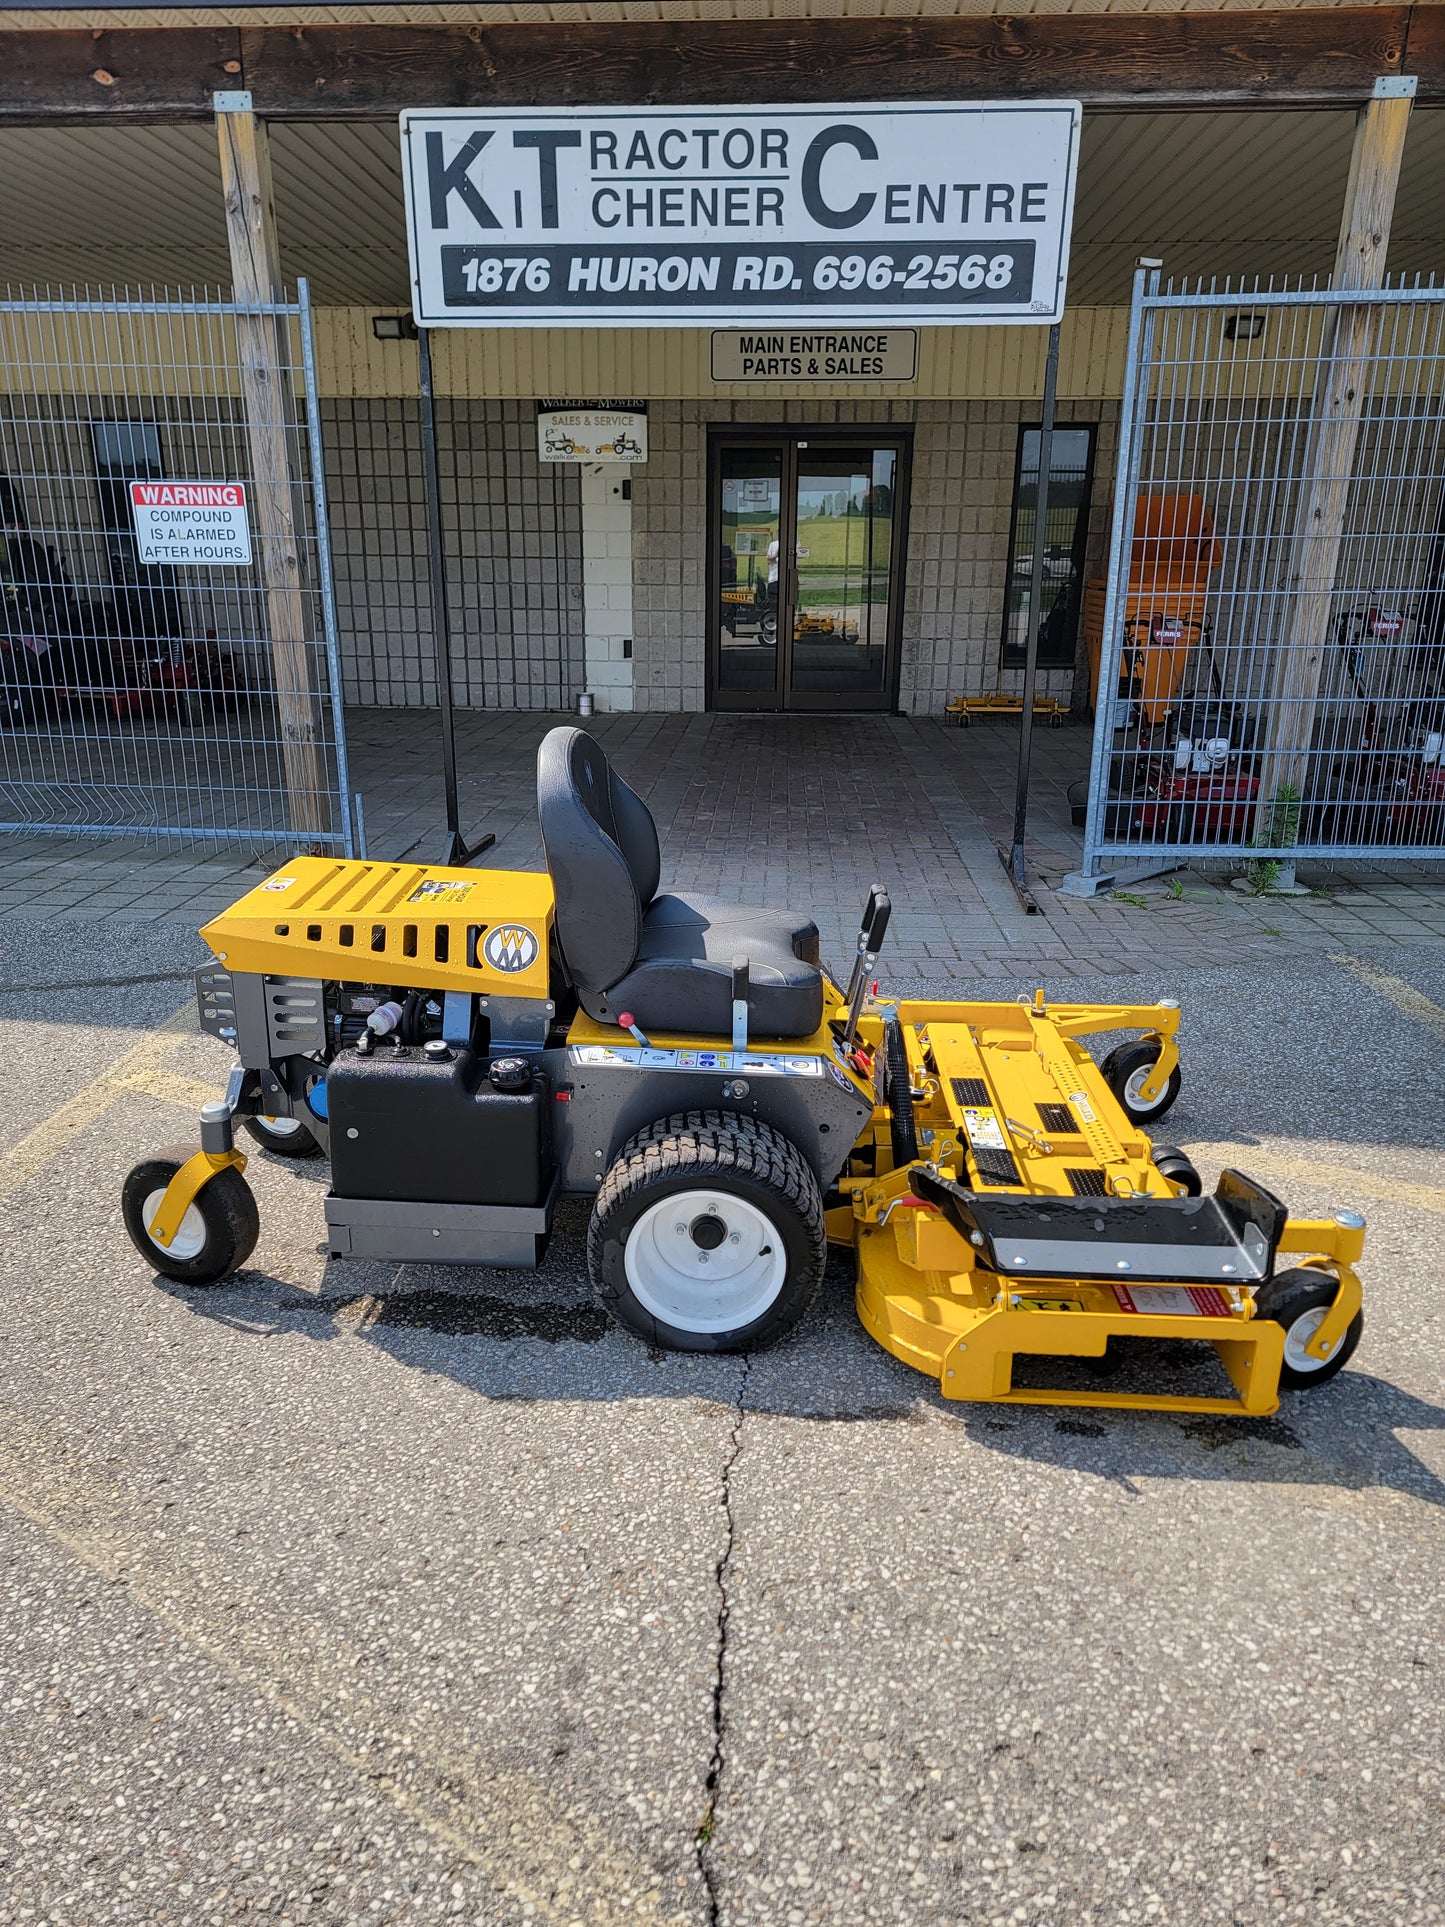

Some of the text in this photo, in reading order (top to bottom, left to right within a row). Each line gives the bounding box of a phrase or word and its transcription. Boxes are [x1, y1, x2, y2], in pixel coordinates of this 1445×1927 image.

[462, 254, 1014, 292] 1876 HURON RD. 696-2568
[739, 335, 888, 355] MAIN ENTRANCE
[743, 357, 884, 376] PARTS & SALES
[552, 416, 634, 426] SALES & SERVICE
[139, 486, 237, 505] WARNING
[150, 510, 232, 522] COMPOUND
[150, 527, 235, 541] IS ALARMED
[145, 546, 246, 558] AFTER HOURS.
